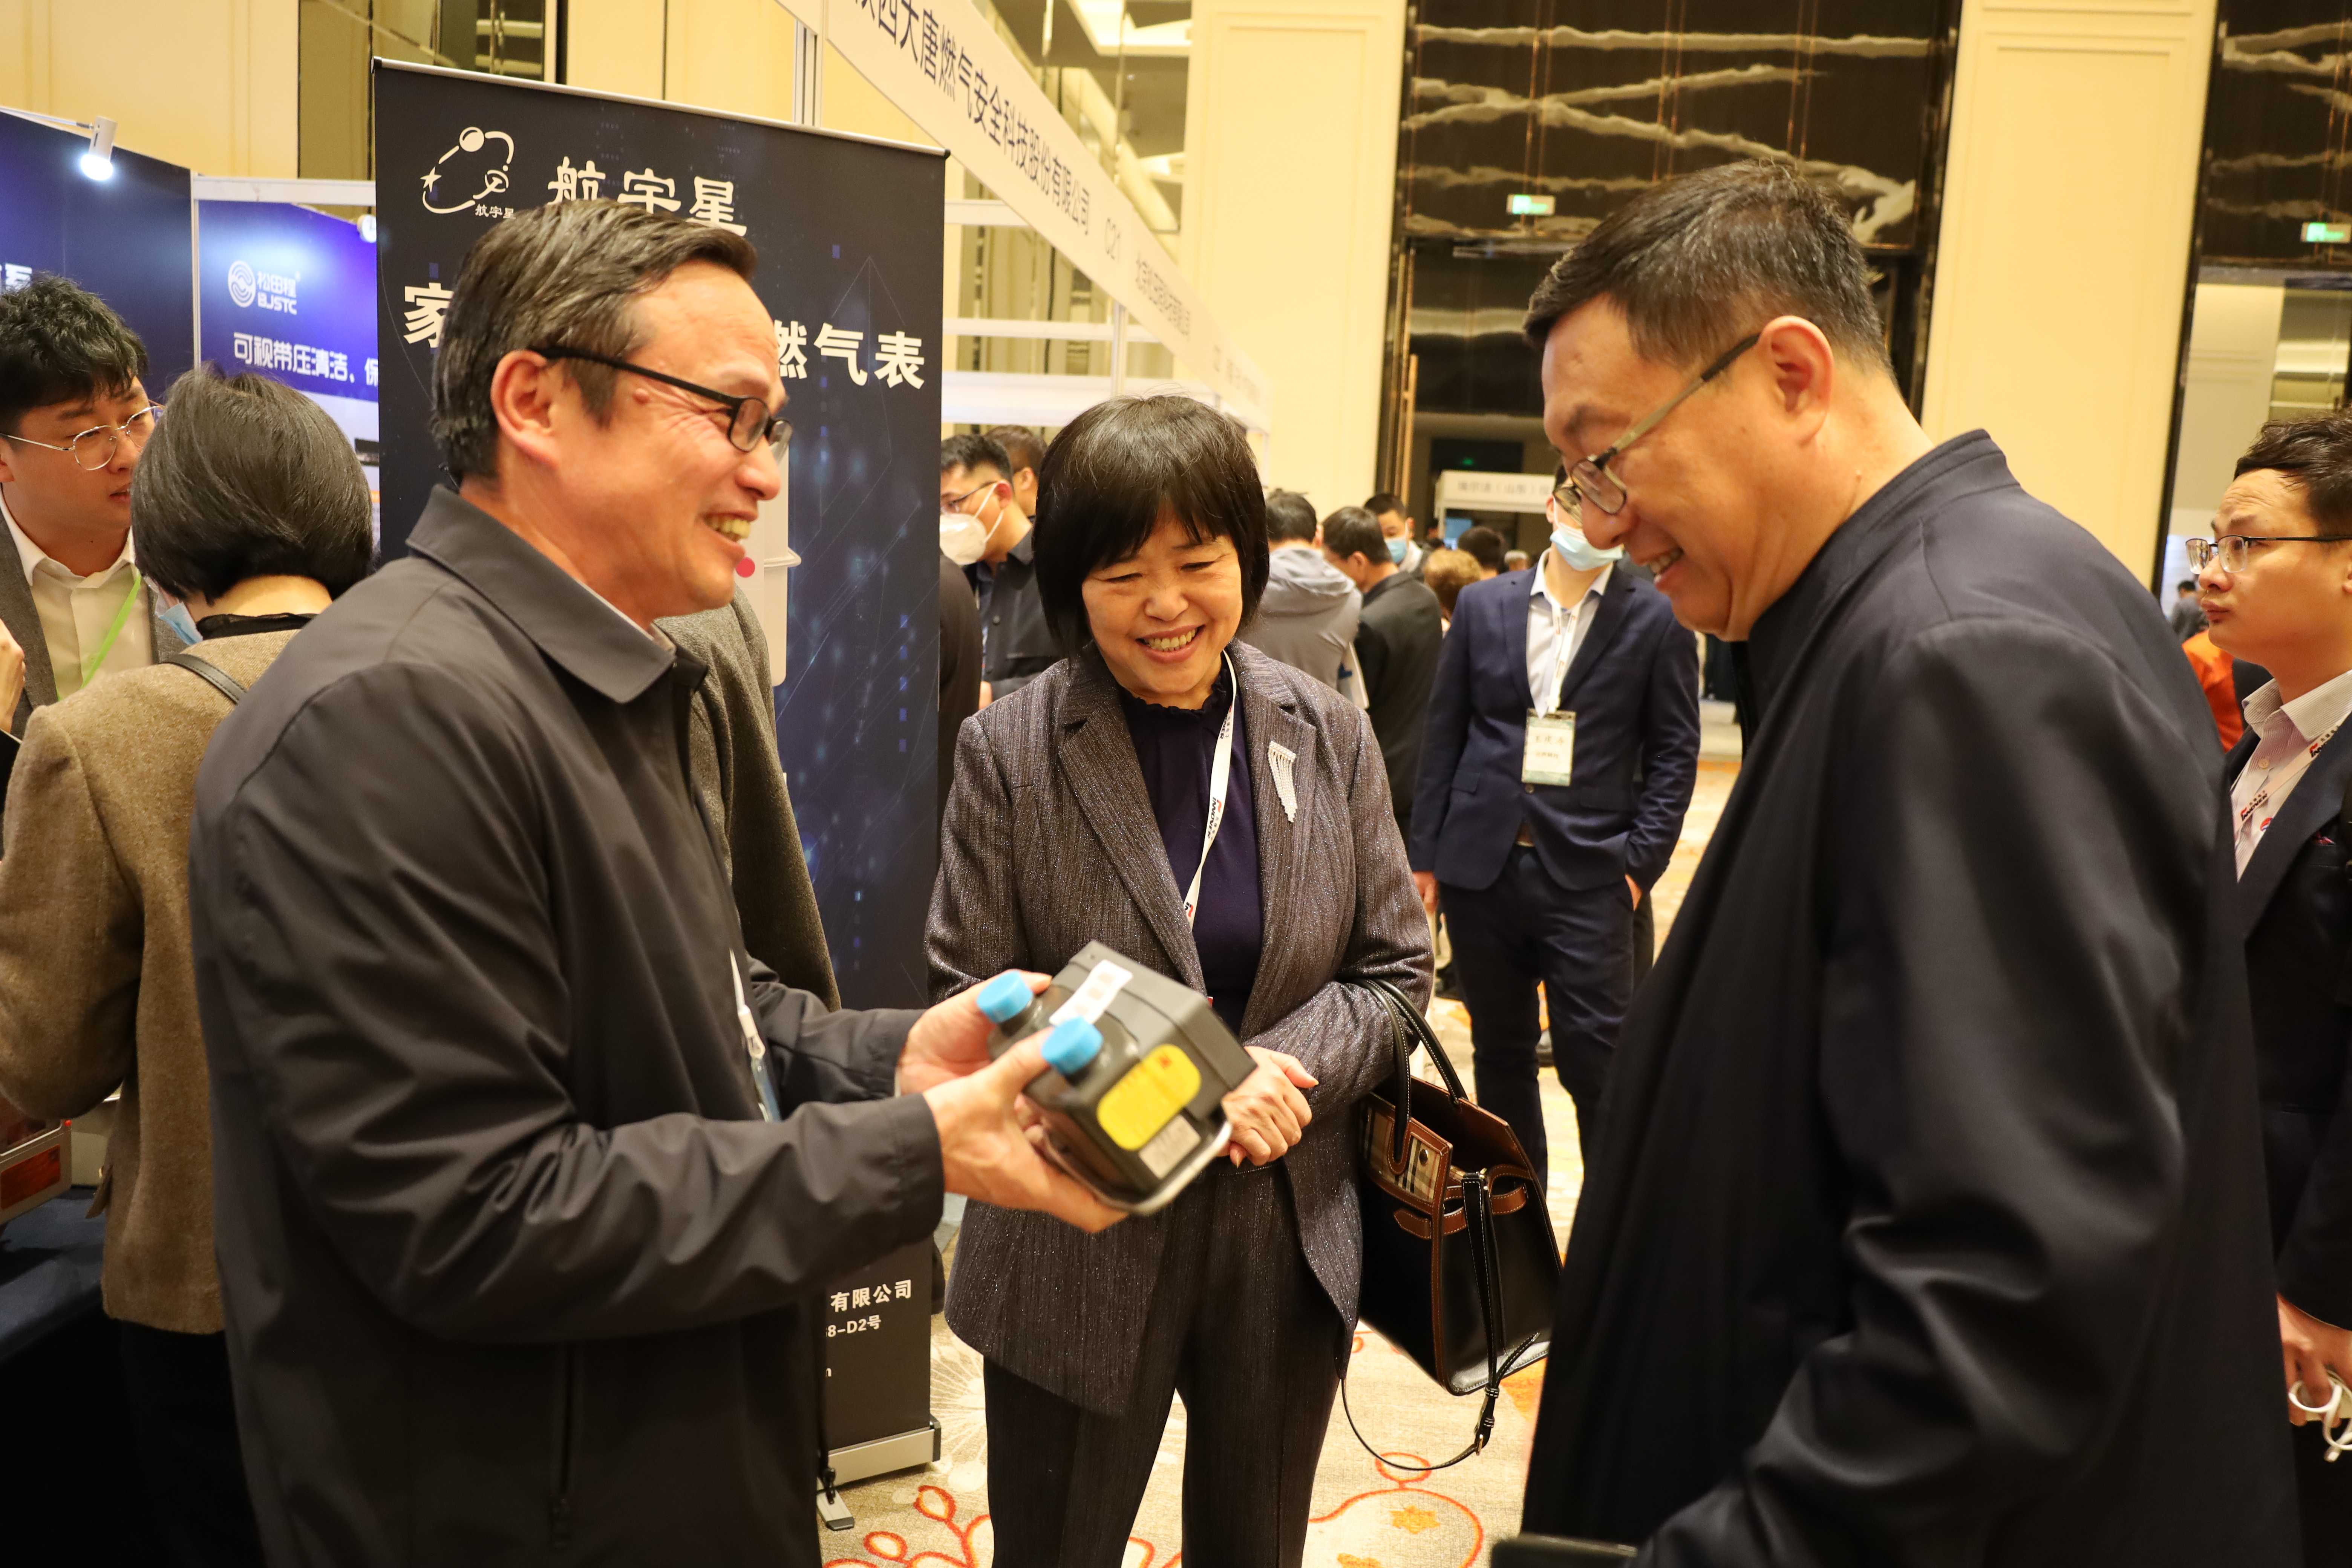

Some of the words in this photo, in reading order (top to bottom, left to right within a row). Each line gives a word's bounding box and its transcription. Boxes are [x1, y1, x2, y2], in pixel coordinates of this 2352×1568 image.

[548, 156, 747, 236] 航宇星
[475, 204, 516, 219] 航宇星
[257, 291, 298, 315] BJSTC
[830, 1279, 912, 1312] 有限公司
[825, 1314, 882, 1338] 8-D2号
